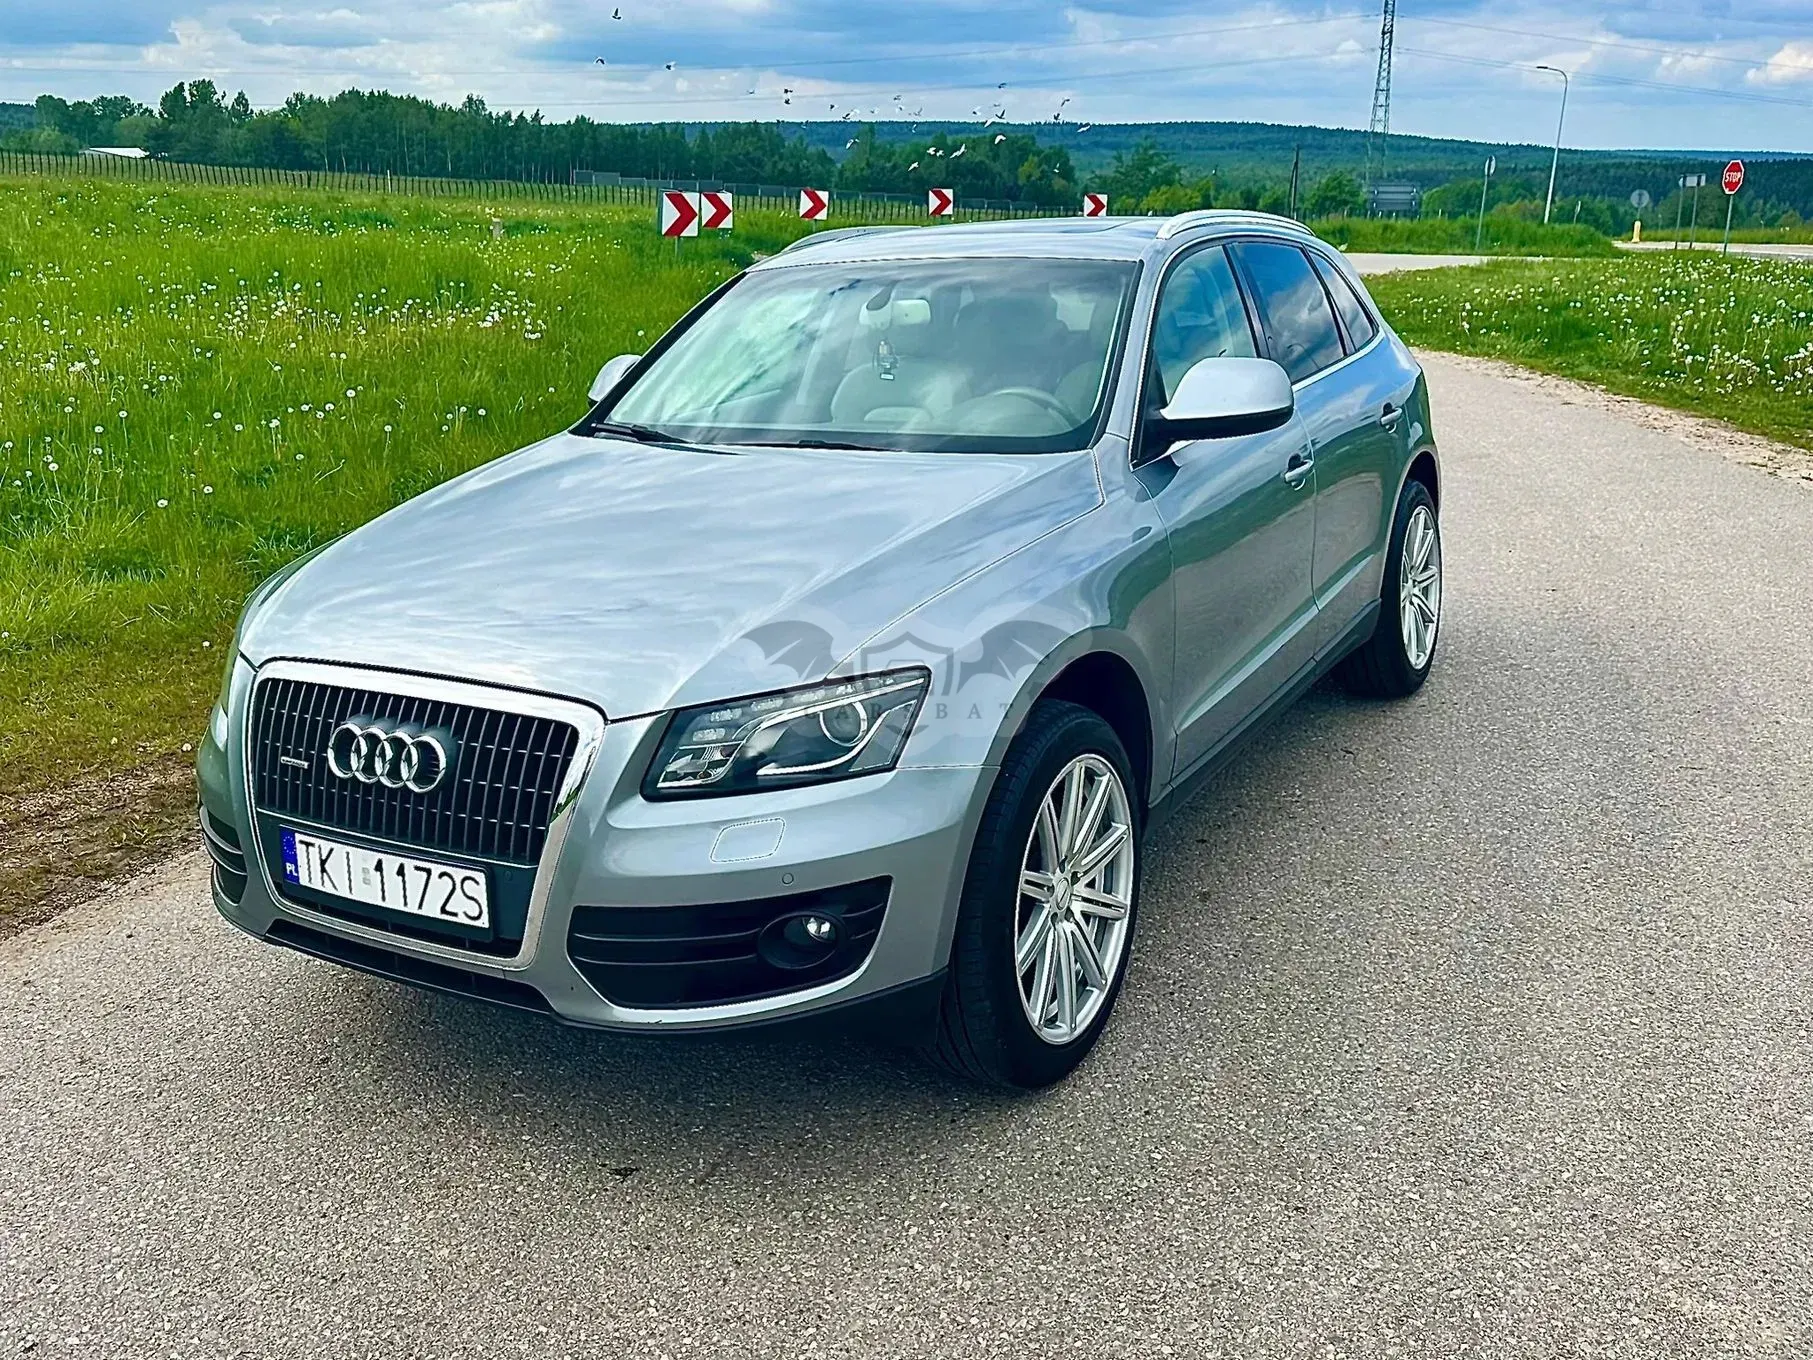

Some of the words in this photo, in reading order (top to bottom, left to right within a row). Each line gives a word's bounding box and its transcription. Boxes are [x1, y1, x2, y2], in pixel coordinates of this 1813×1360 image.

[1725, 171, 1741, 183] STOP
[285, 862, 298, 877] PL
[298, 839, 353, 895] TKI
[374, 857, 484, 921] 1172S
